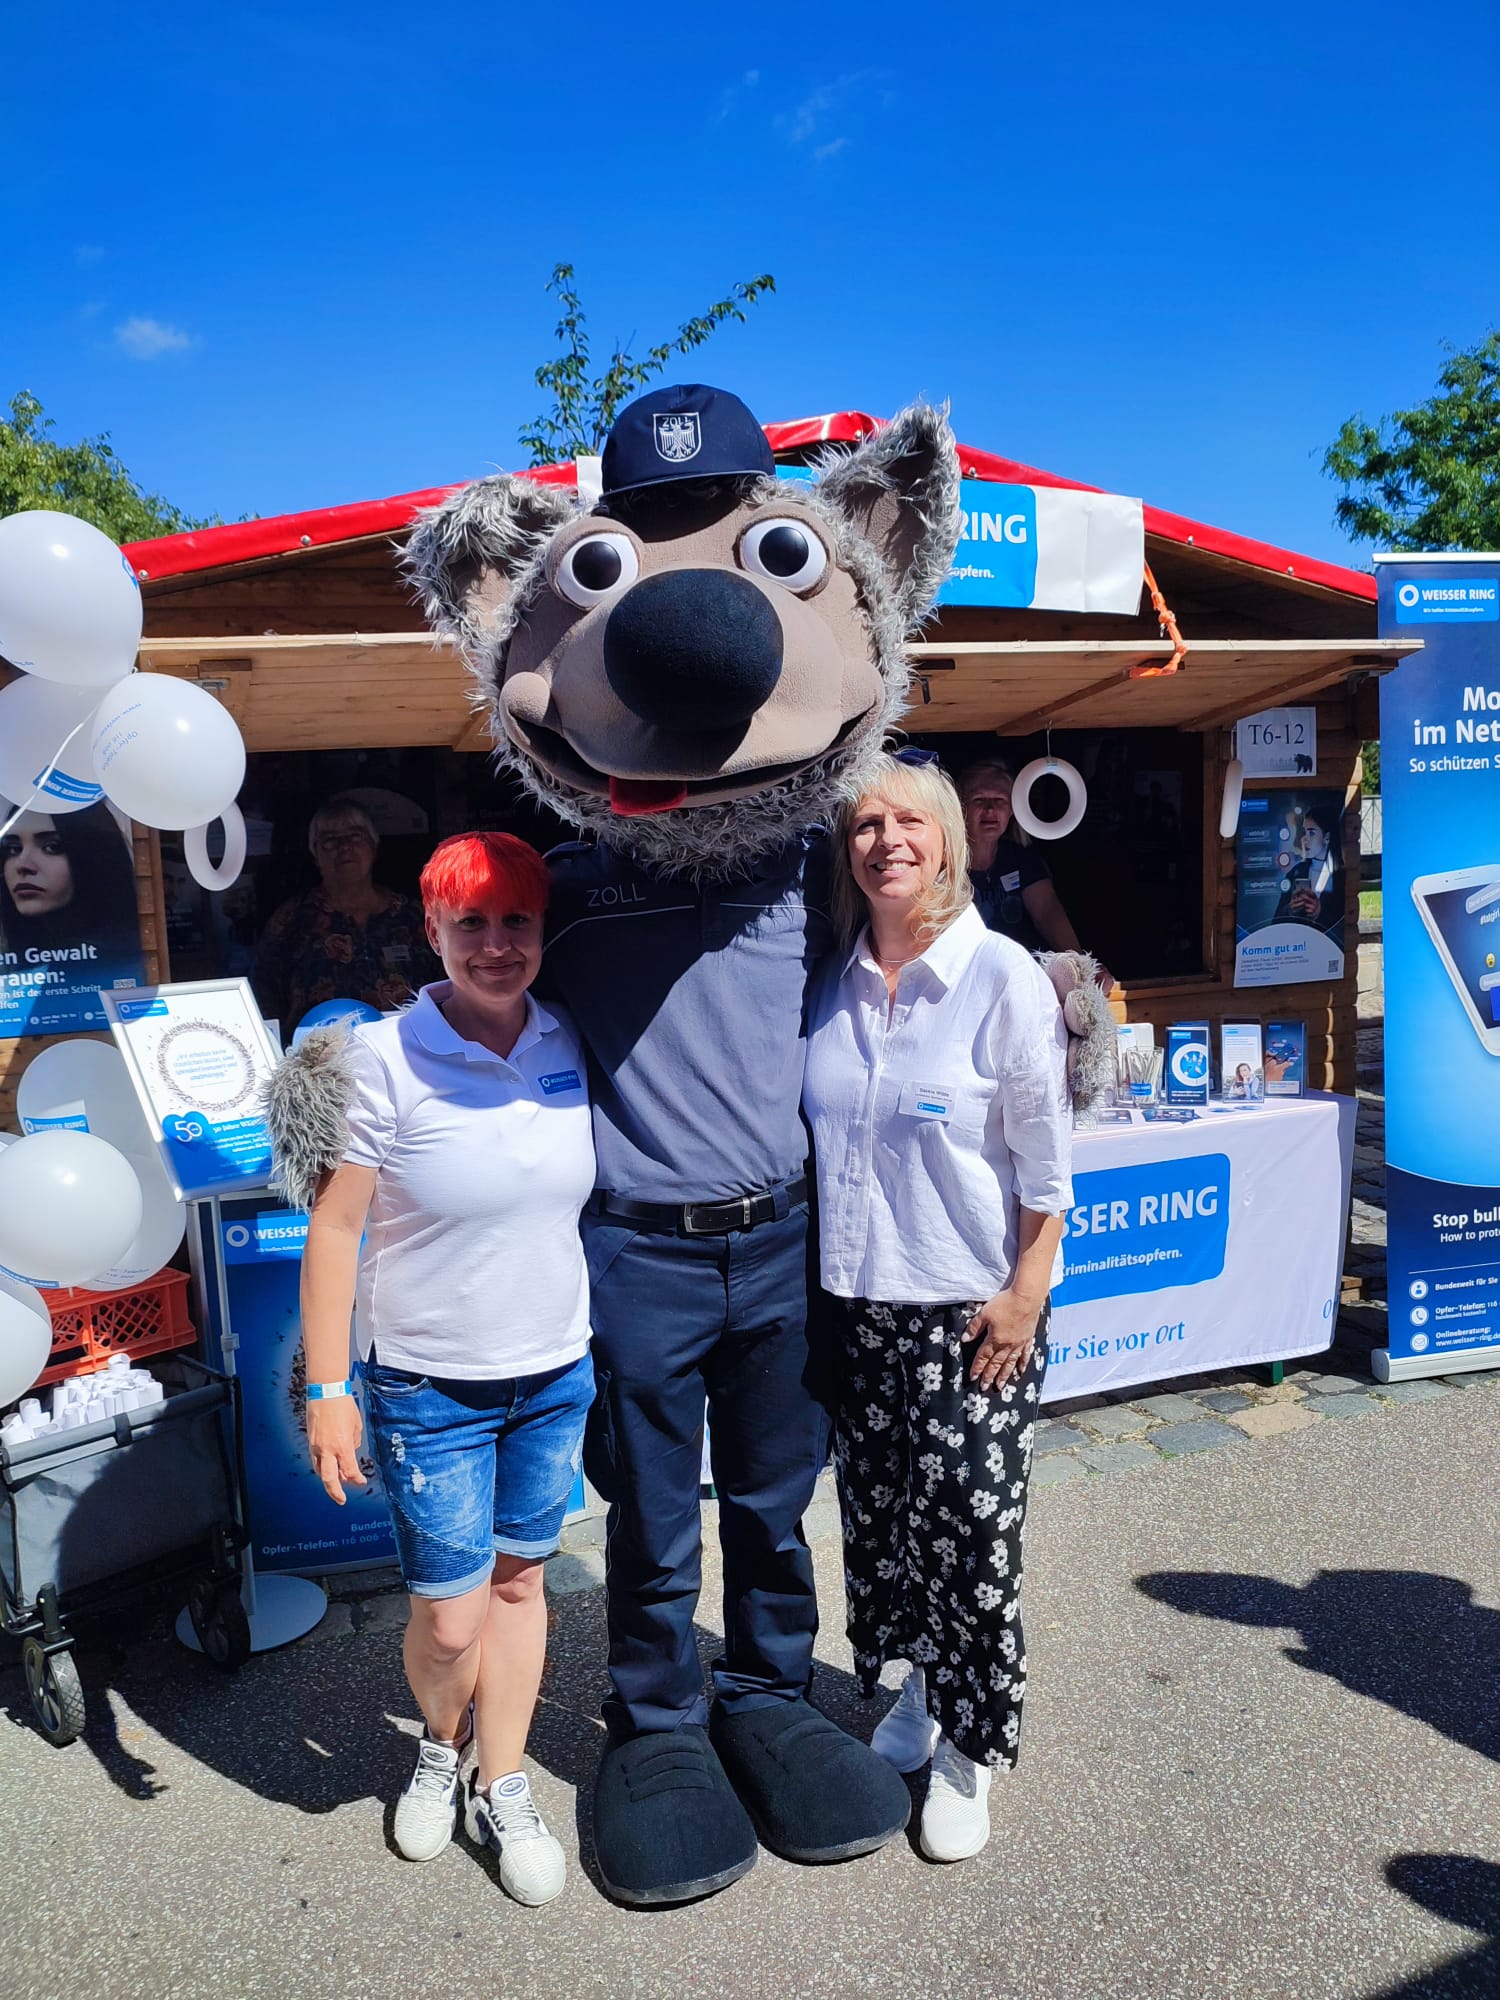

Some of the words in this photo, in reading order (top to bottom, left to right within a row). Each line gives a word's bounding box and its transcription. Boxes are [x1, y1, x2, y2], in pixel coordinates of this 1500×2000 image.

[662, 416, 692, 427] ZOLL
[1422, 589, 1466, 601] WEISSER
[1469, 588, 1495, 601] RING
[1463, 687, 1500, 711] Mo
[1248, 723, 1304, 745] T6-12
[1414, 719, 1446, 745] im
[1409, 758, 1426, 773] So
[1429, 755, 1490, 772] schützen
[585, 883, 646, 907] ZOLL
[25, 943, 98, 964] Gewalt
[1241, 946, 1272, 956] Komm
[1274, 944, 1290, 956] gut
[1293, 940, 1306, 952] an!
[13, 988, 26, 998] ist
[27, 987, 42, 997] der
[45, 987, 70, 996] erste
[71, 984, 102, 994] Schritt
[1139, 1186, 1218, 1229] RING
[1432, 1213, 1469, 1230] Stop
[253, 1226, 309, 1240] WEISSER
[1441, 1232, 1463, 1243] How
[1466, 1231, 1476, 1241] to
[1435, 1280, 1475, 1291] Bundesweit
[1476, 1278, 1487, 1287] für
[1488, 1276, 1498, 1286] Sie
[1435, 1302, 1486, 1316] Opfer-Telefon:
[1435, 1327, 1491, 1340] Onlineberatung:
[1048, 1341, 1071, 1365] ür
[1076, 1335, 1109, 1359] Sie
[1116, 1331, 1150, 1353] vor
[1156, 1321, 1185, 1345] Ort
[262, 1540, 338, 1557] Opfer-Telefon:
[341, 1536, 357, 1545] 116
[359, 1533, 379, 1544] 006
